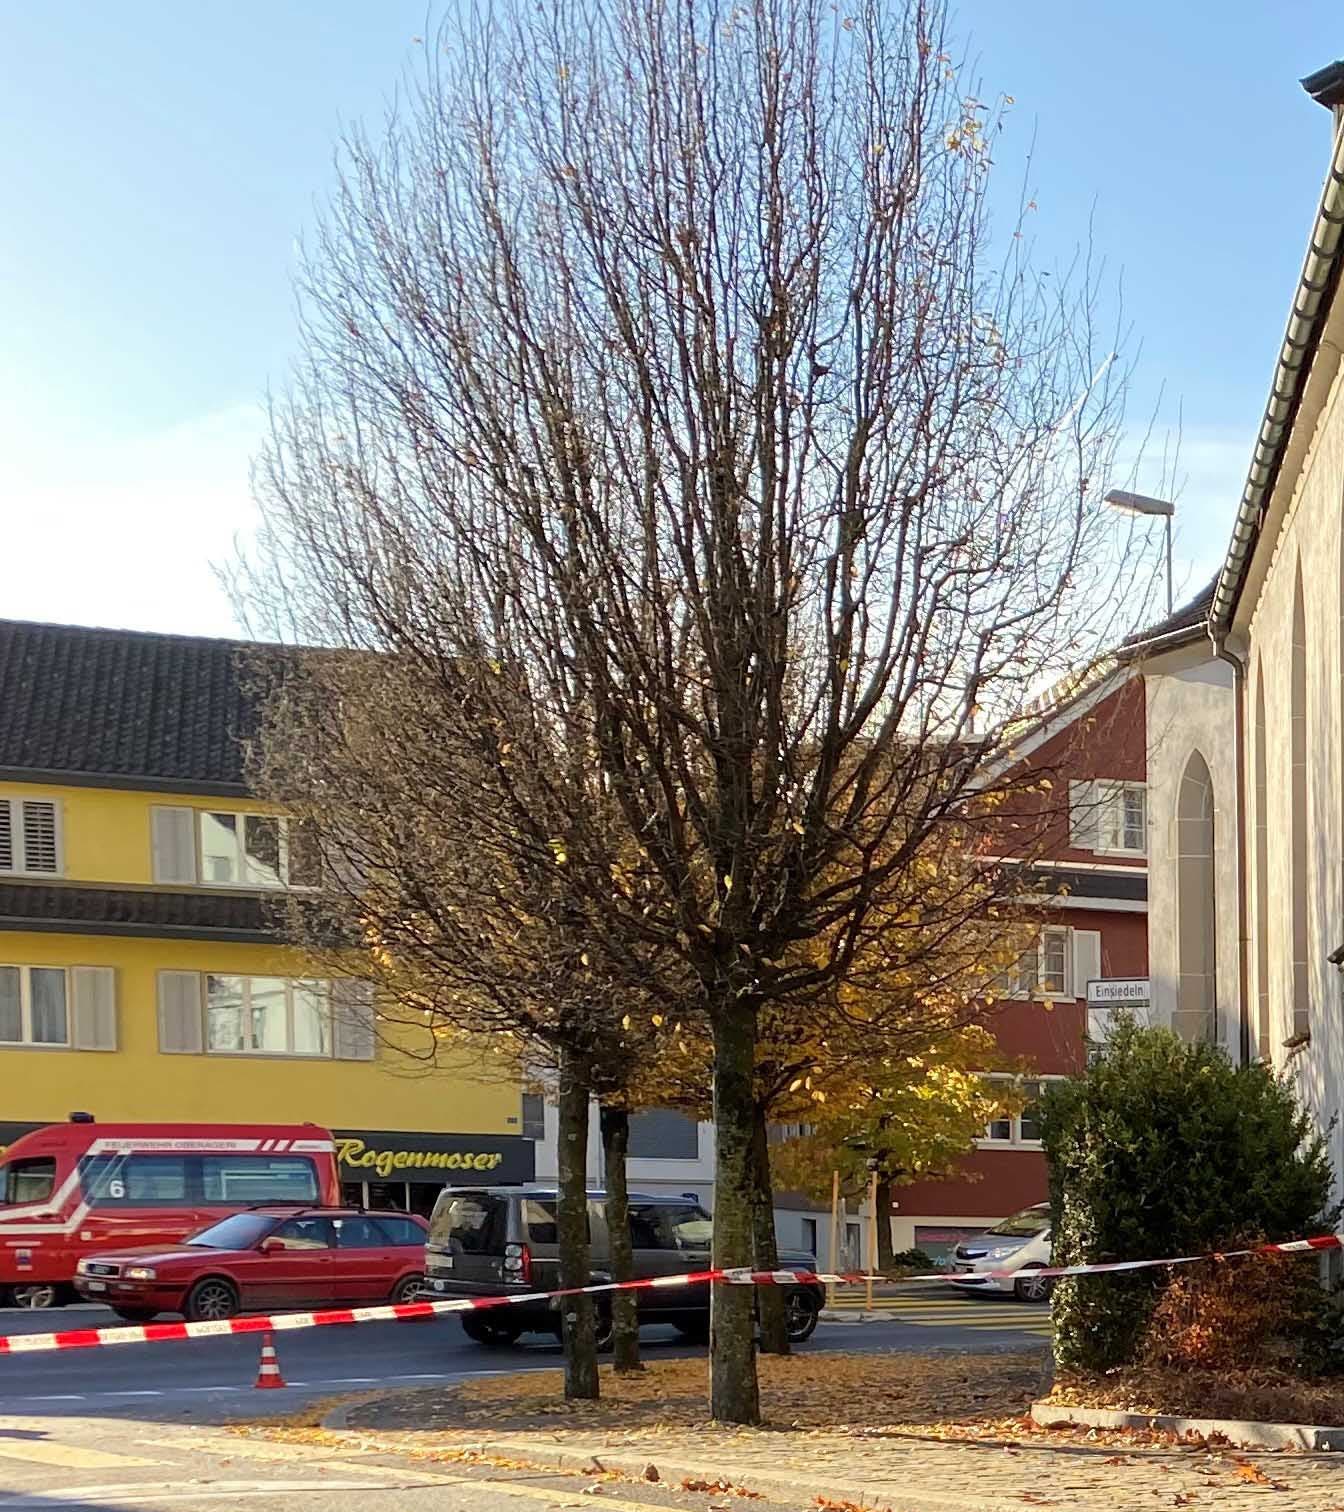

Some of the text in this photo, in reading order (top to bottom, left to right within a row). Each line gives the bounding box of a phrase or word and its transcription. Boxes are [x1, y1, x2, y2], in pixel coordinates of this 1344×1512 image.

[1096, 984, 1144, 998] Einsiedeln
[335, 1139, 502, 1176] Rogenmoser
[110, 1180, 125, 1199] 6
